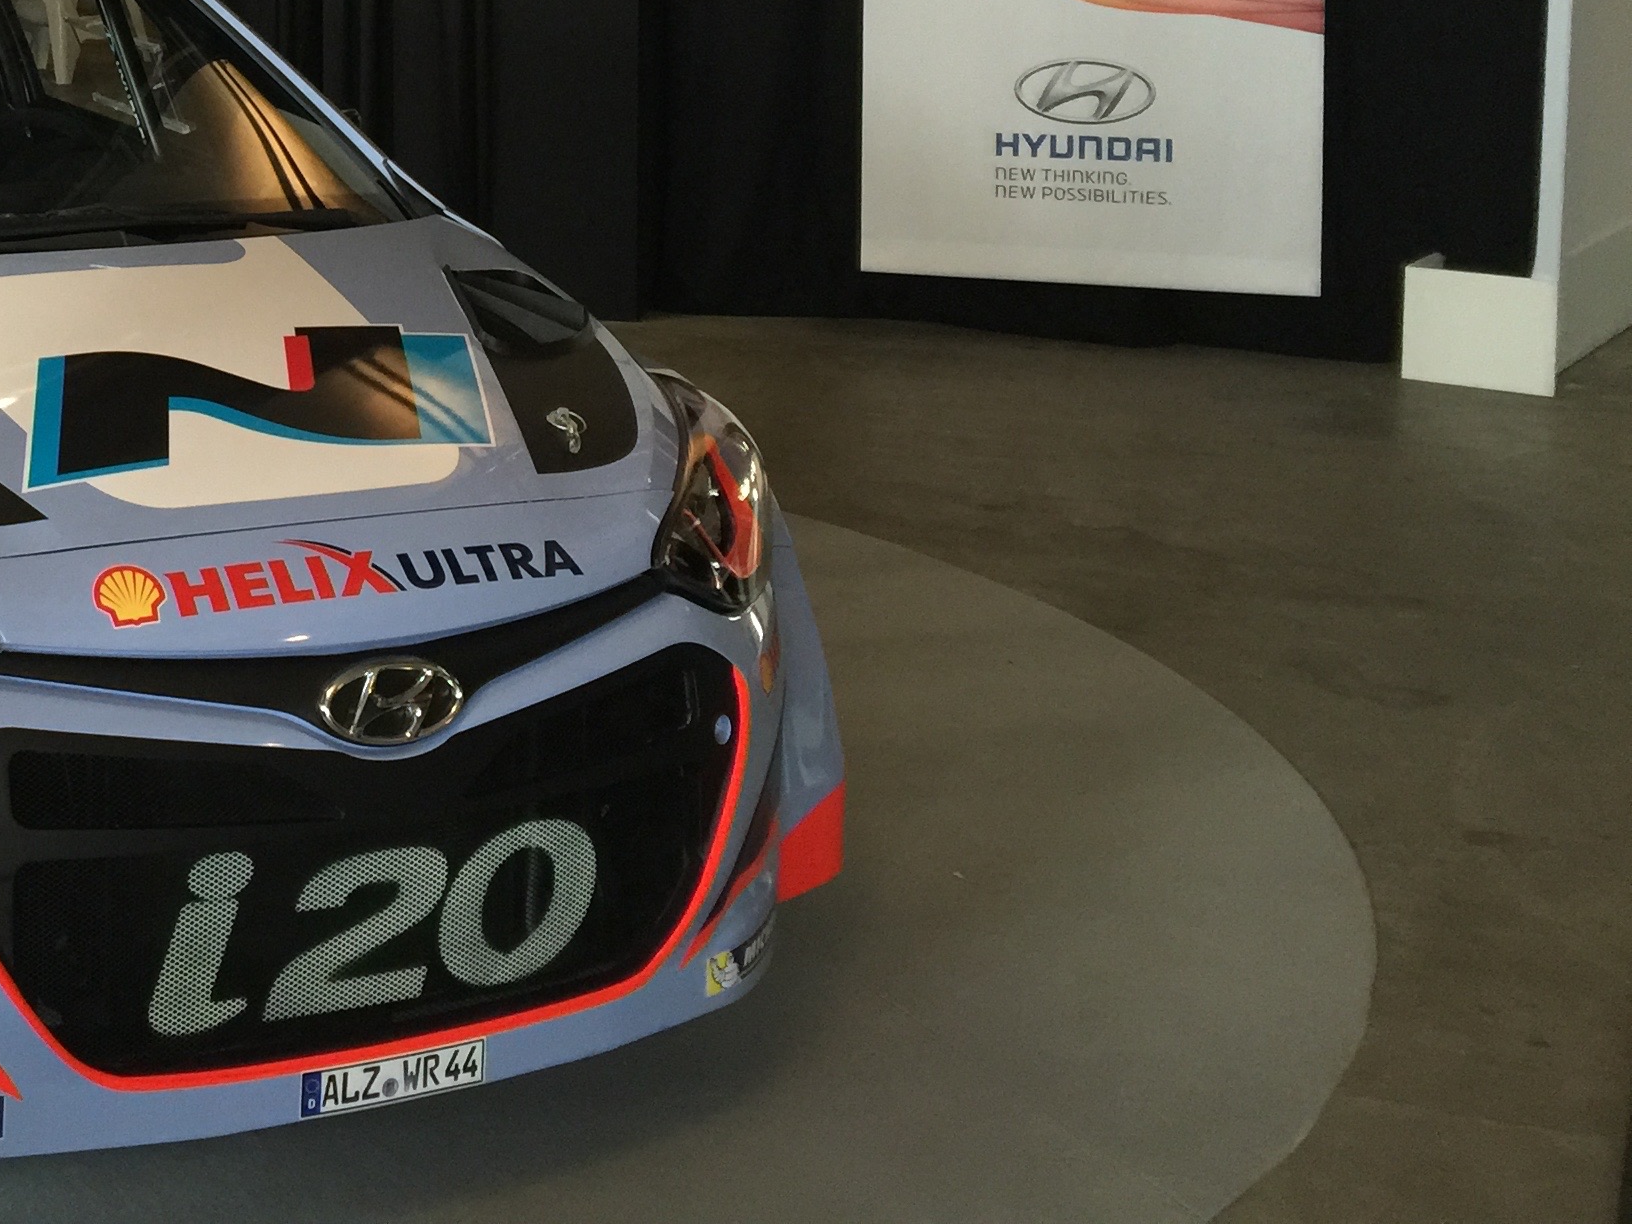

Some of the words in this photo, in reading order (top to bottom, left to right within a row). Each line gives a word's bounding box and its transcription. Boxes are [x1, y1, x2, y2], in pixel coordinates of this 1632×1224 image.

[995, 132, 1173, 163] HYUNDAI
[995, 167, 1036, 182] NEW
[1042, 168, 1131, 186] THINKING.
[995, 184, 1036, 200] NEW
[1042, 186, 1173, 206] POSSIBILITIES.
[165, 539, 404, 617] HELIX
[396, 539, 584, 590] ULTRA
[148, 818, 597, 1037] i20
[322, 1065, 381, 1108] ALZ
